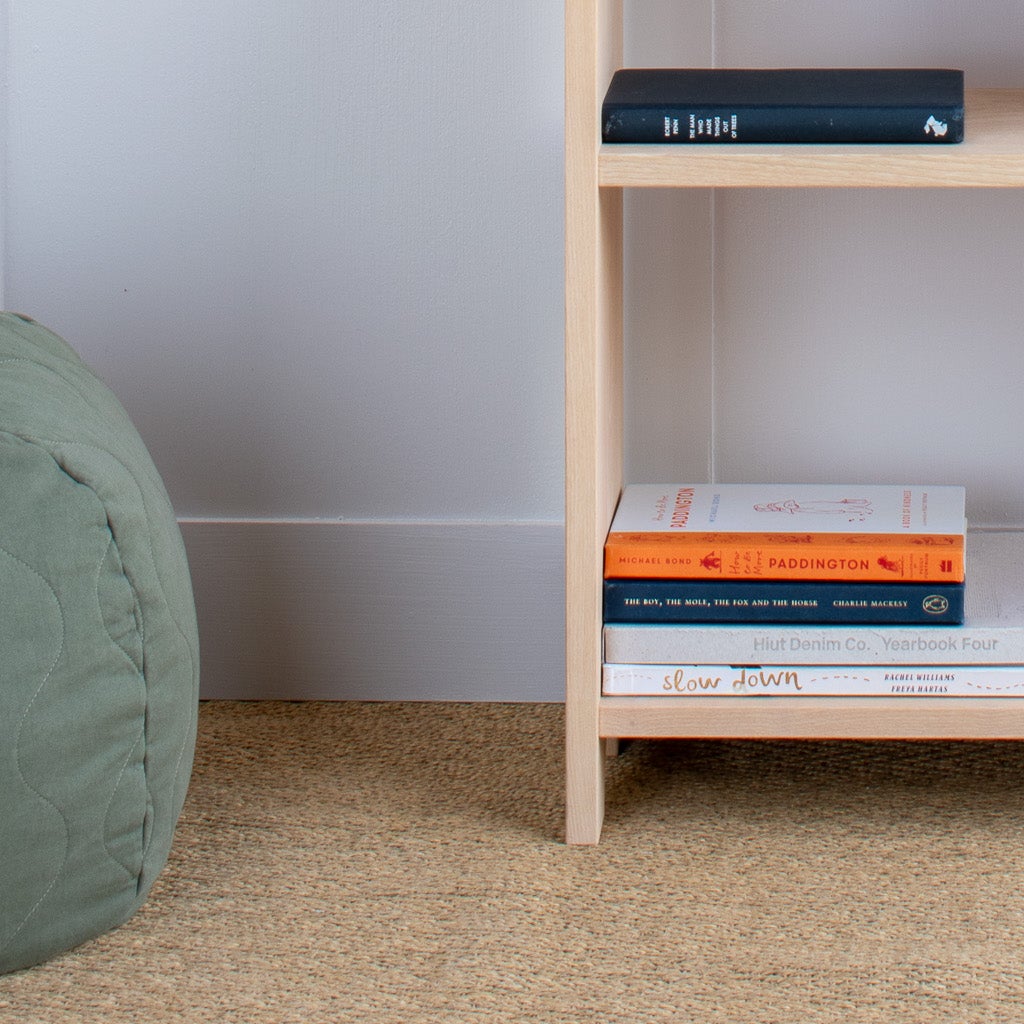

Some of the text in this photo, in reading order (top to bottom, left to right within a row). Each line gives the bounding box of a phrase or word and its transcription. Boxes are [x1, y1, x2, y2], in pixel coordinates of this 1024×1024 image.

[731, 130, 738, 139] OF
[670, 487, 695, 528] PADDINGTON
[619, 557, 661, 565] MICHAEL
[769, 558, 870, 571] PADDINGTON
[624, 598, 640, 606] THE
[643, 598, 663, 607] BOY,
[666, 598, 682, 606] THE
[685, 598, 711, 607] MOLE,
[714, 598, 730, 606] THE
[733, 598, 749, 606] FOX
[772, 599, 788, 607] THE
[791, 599, 818, 607] HORSE
[753, 637, 998, 651] Hiut Denim Co. Yearbook Four
[662, 669, 803, 692] slow down
[884, 673, 956, 681] RACHEL WILLIAMS
[891, 685, 948, 693] FREYA HARTAS
